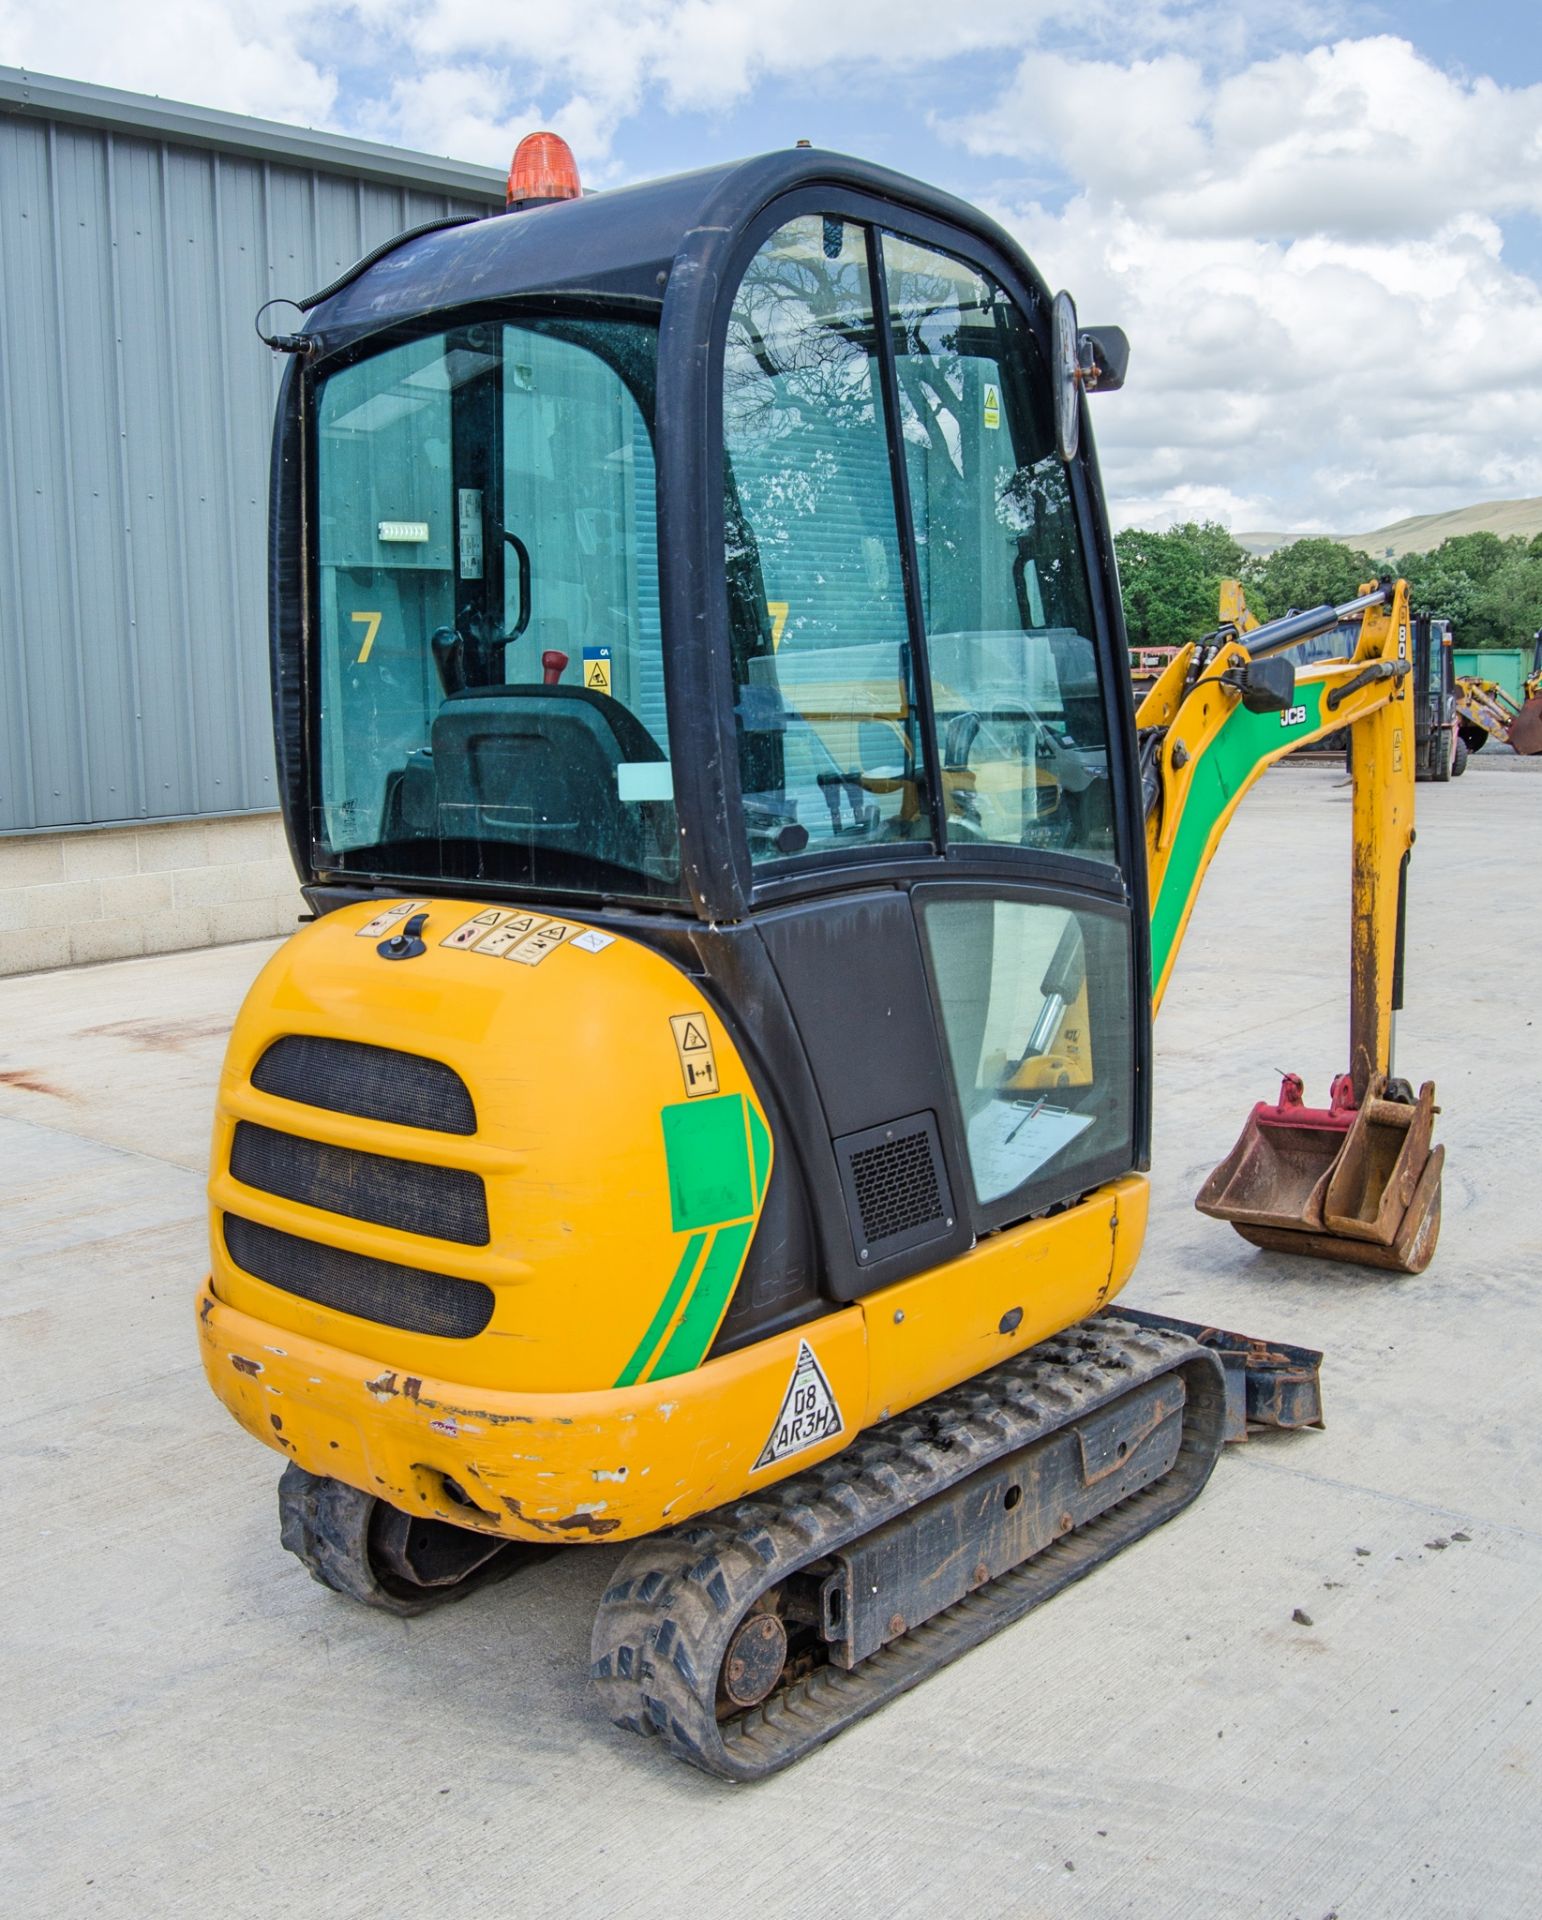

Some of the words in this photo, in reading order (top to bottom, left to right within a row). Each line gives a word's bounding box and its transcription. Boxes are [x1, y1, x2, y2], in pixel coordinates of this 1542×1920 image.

[351, 611, 382, 663] 7
[1280, 705, 1306, 727] JCB
[777, 1406, 829, 1449] AR3H
